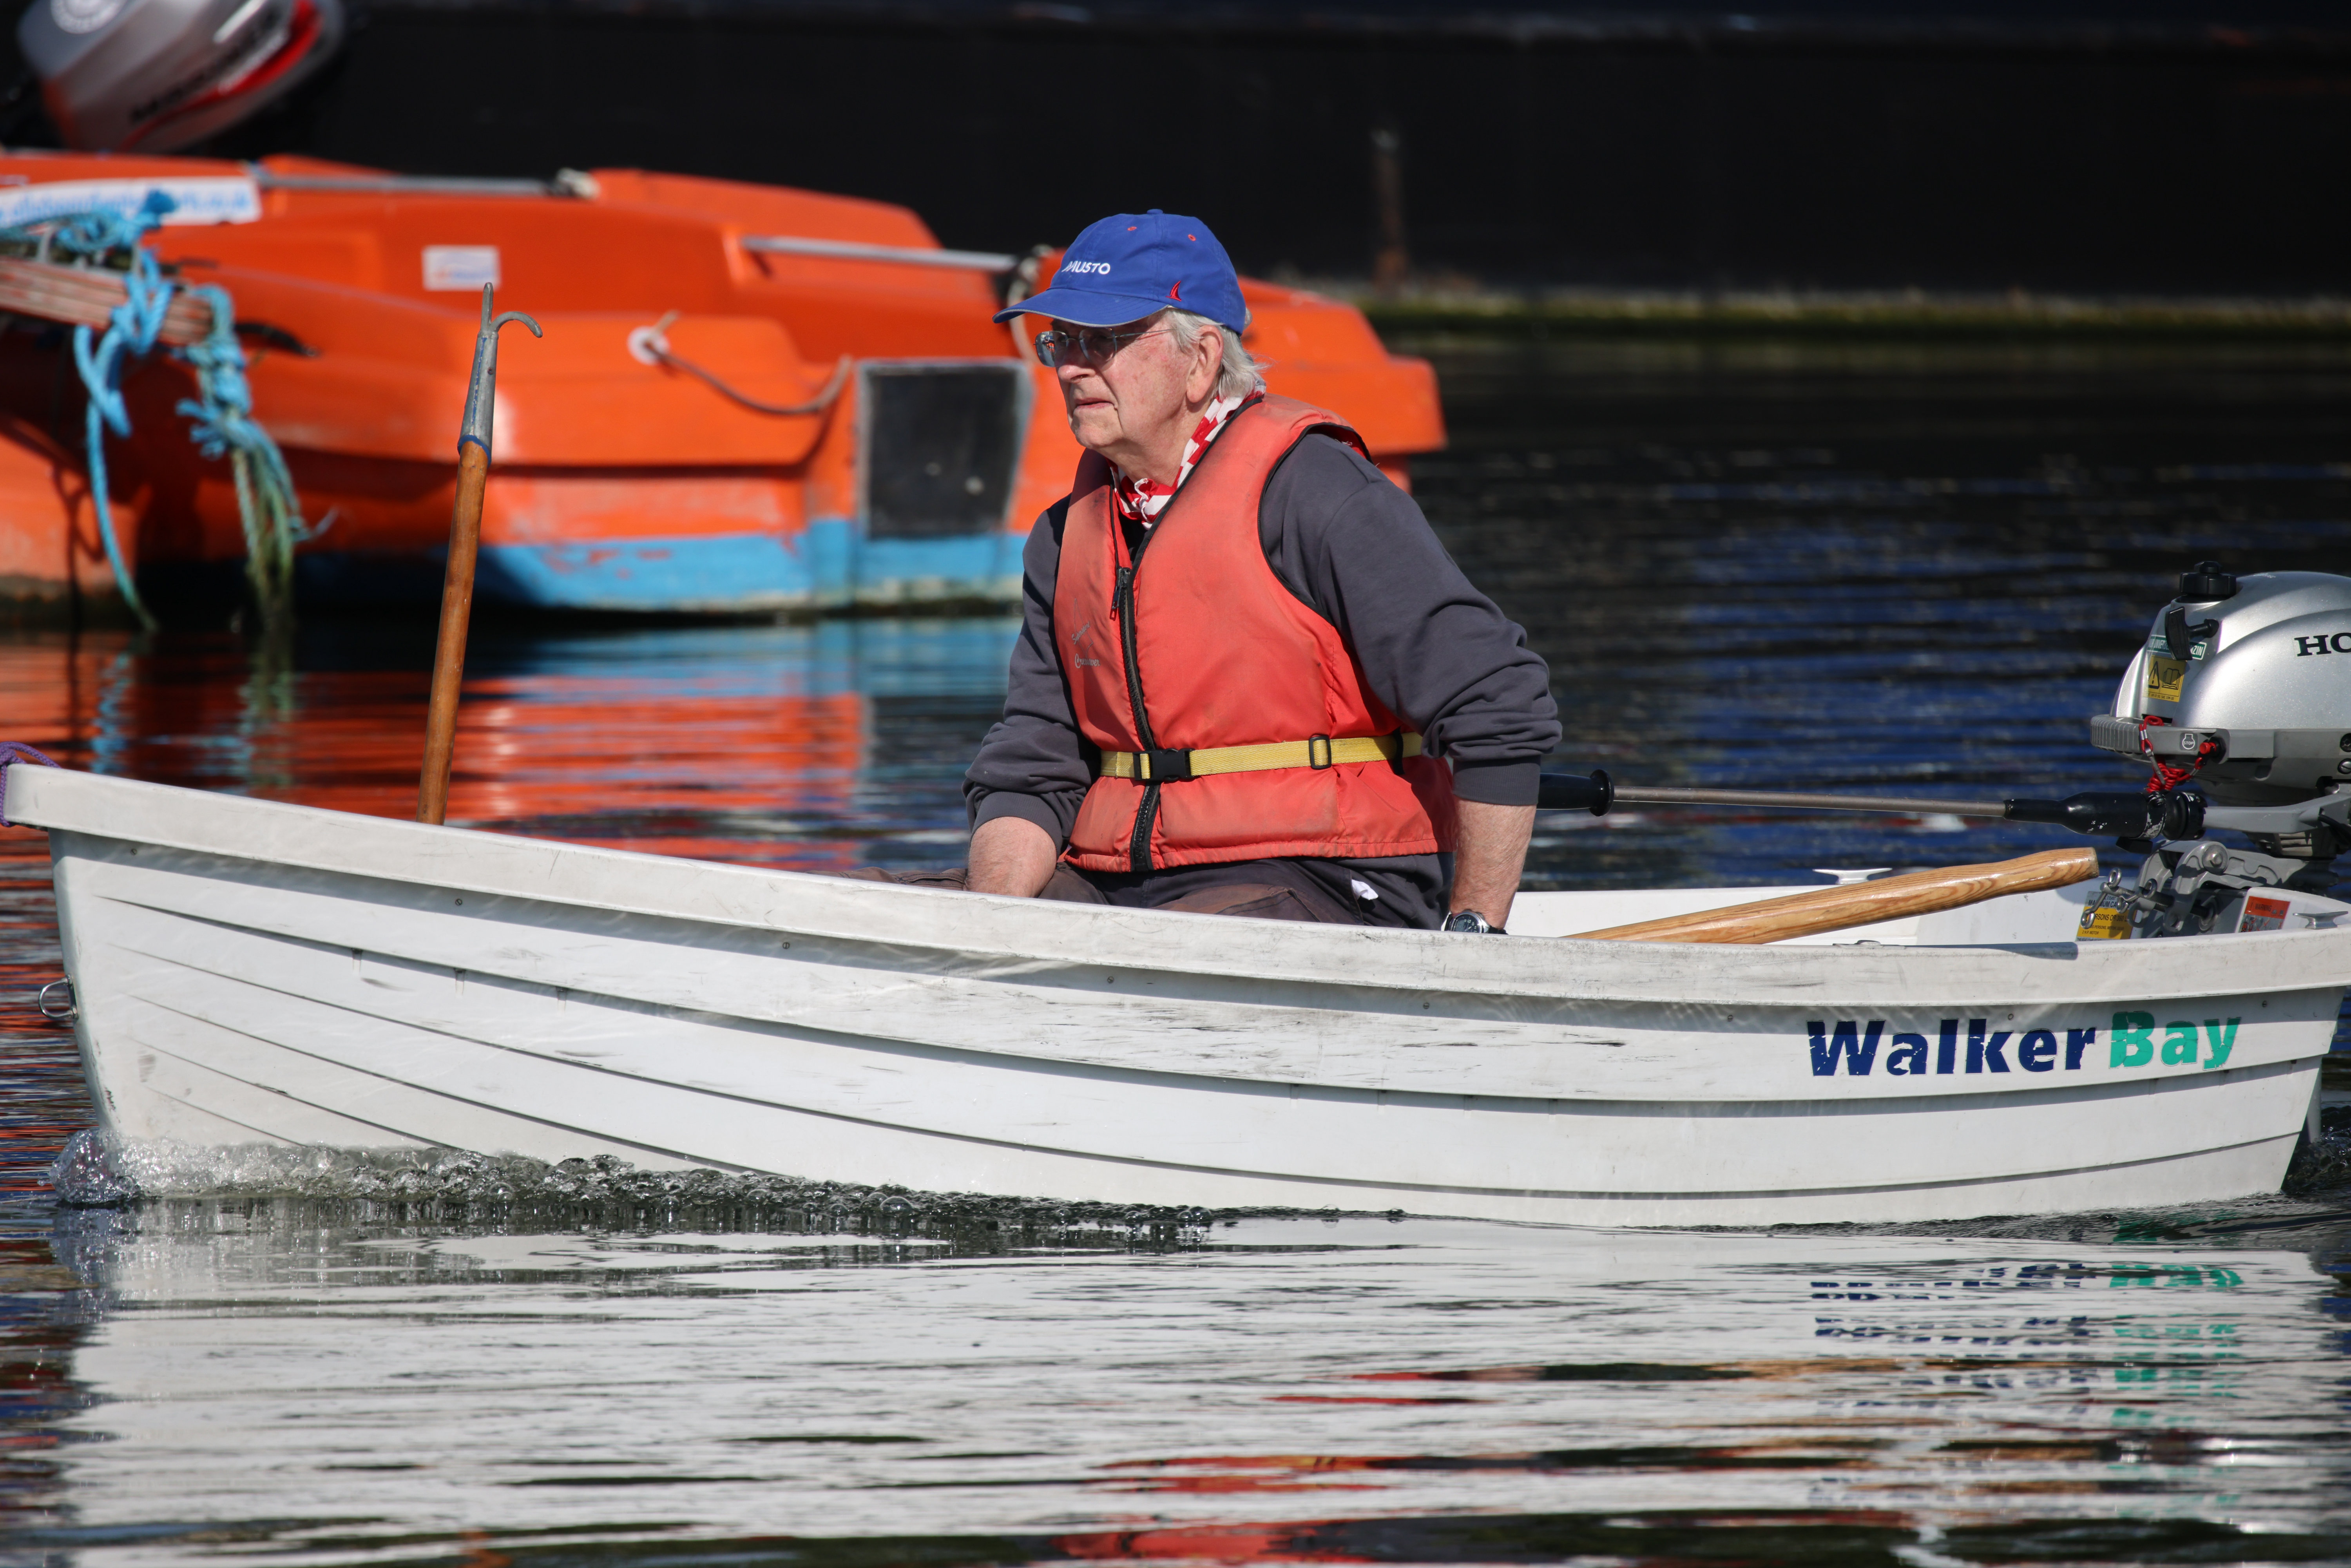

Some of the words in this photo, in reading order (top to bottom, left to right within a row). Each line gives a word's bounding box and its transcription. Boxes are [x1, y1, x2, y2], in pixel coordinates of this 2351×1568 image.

[1061, 261, 1110, 275] MUSTO
[2294, 632, 2351, 657] HO
[1806, 1018, 2097, 1076] Walker
[2109, 1011, 2242, 1070] Bay
